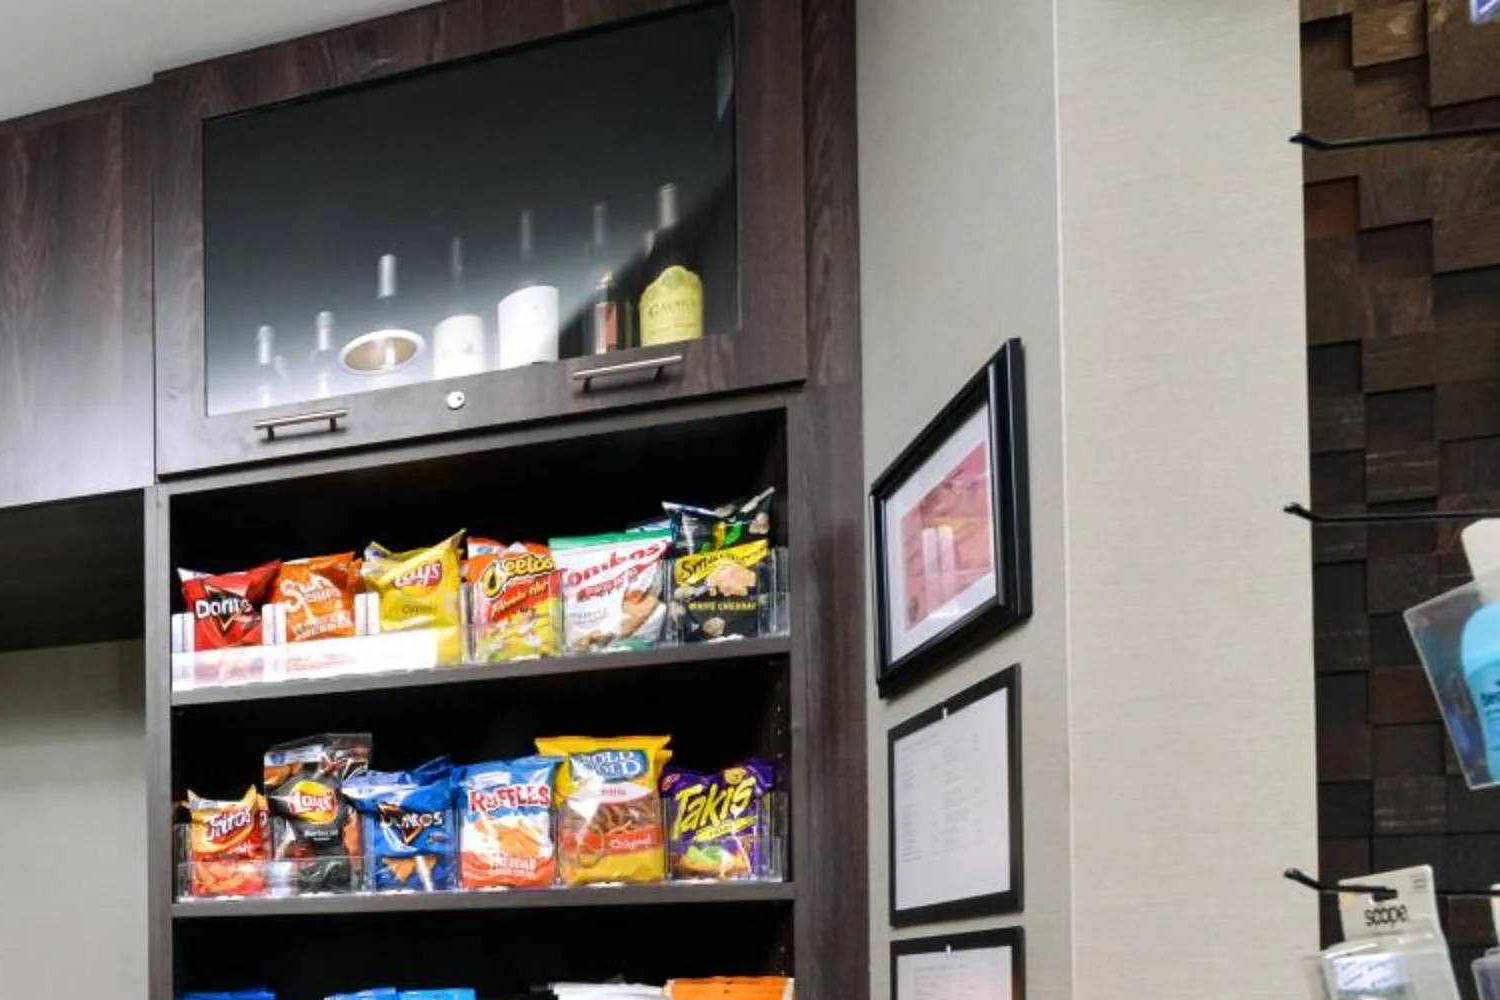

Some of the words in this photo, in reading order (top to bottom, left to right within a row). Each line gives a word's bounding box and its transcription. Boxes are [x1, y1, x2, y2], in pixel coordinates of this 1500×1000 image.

[395, 561, 442, 588] Lay's
[483, 553, 553, 598] Cheetos
[195, 597, 253, 618] Doritos
[469, 784, 550, 812] RUFFLES
[673, 777, 757, 841] Takis
